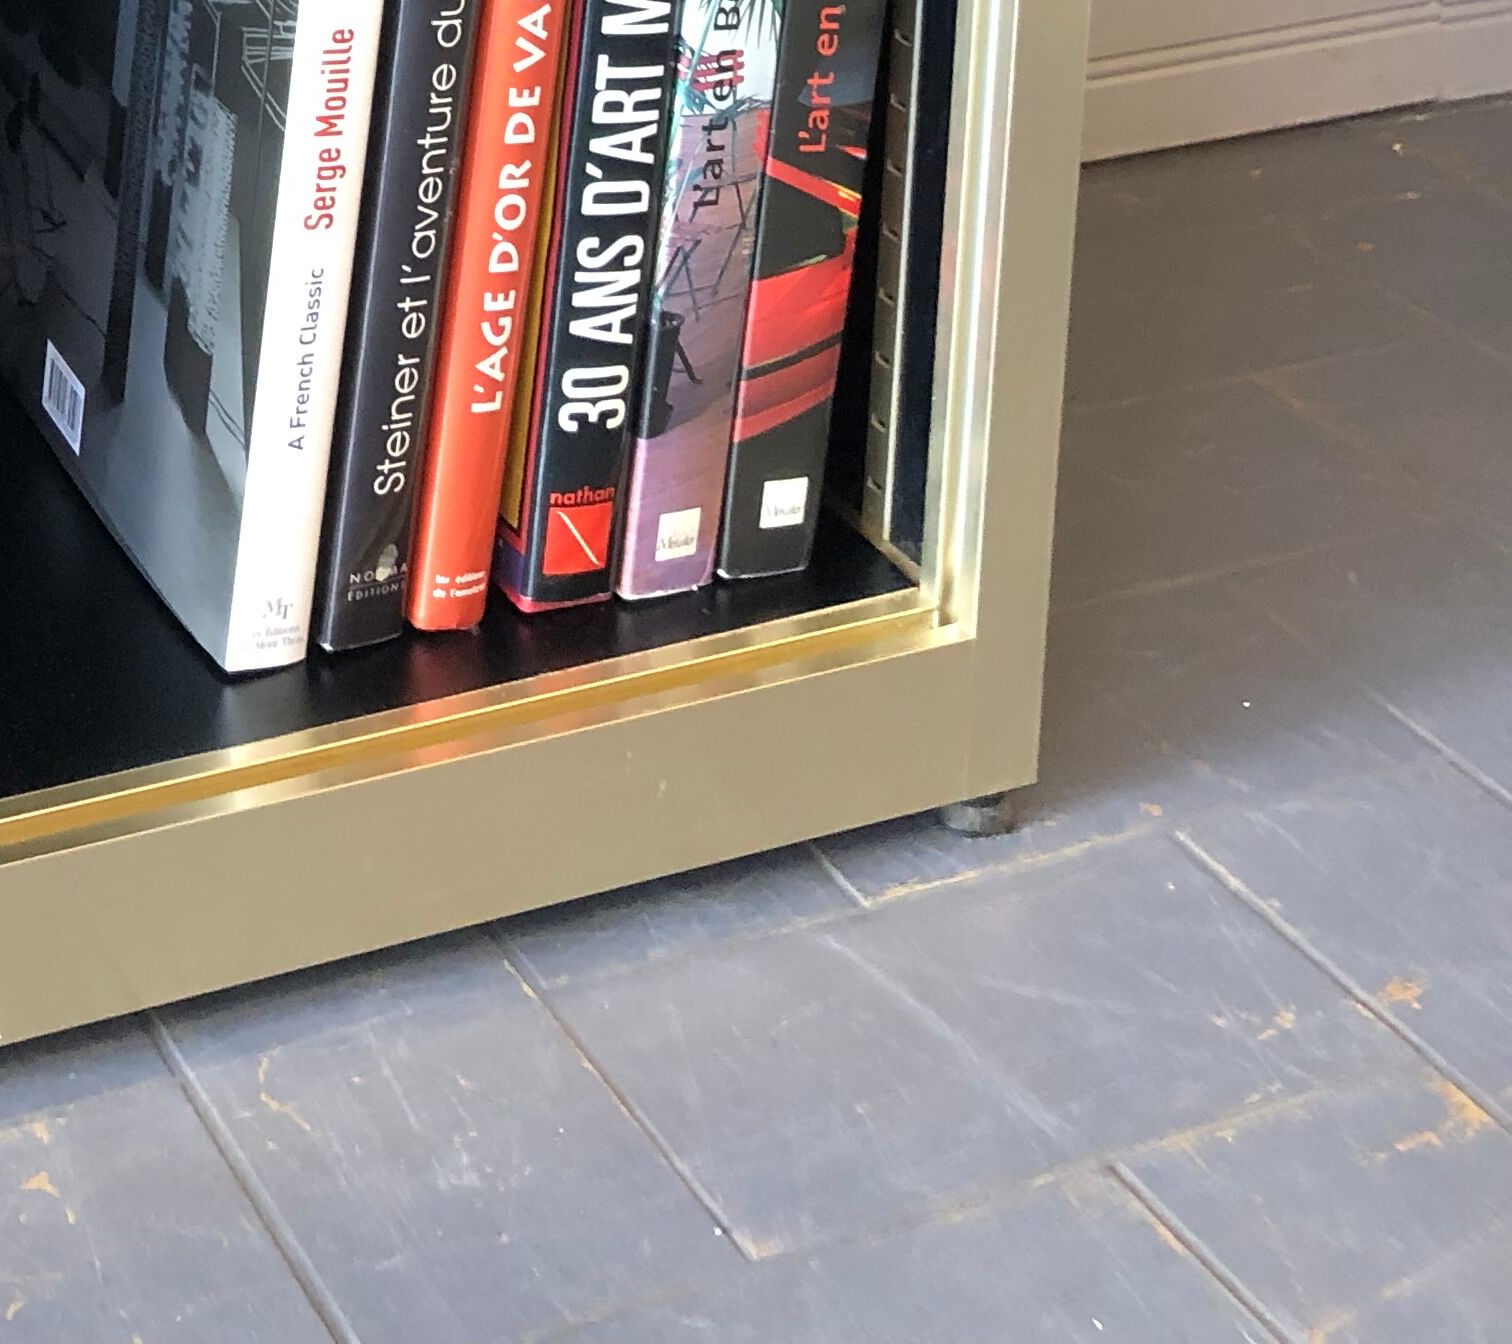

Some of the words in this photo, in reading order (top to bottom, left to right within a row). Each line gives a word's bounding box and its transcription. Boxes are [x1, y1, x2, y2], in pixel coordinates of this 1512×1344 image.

[313, 27, 355, 138] Mouille
[503, 85, 542, 145] DE
[797, 71, 834, 154] L'art
[816, 6, 842, 58] en
[399, 62, 457, 283] l'aventure
[580, 53, 666, 217] D'ART
[303, 146, 347, 232] Serge
[488, 158, 533, 274] D'OR
[298, 267, 325, 345] Classic
[397, 294, 429, 340] et
[568, 234, 646, 346] ANS
[288, 353, 314, 429] French
[471, 288, 517, 414] L'AGE
[557, 363, 631, 434] 30
[288, 434, 306, 451] A
[373, 355, 421, 495] Steiner
[549, 485, 616, 506] nathan
